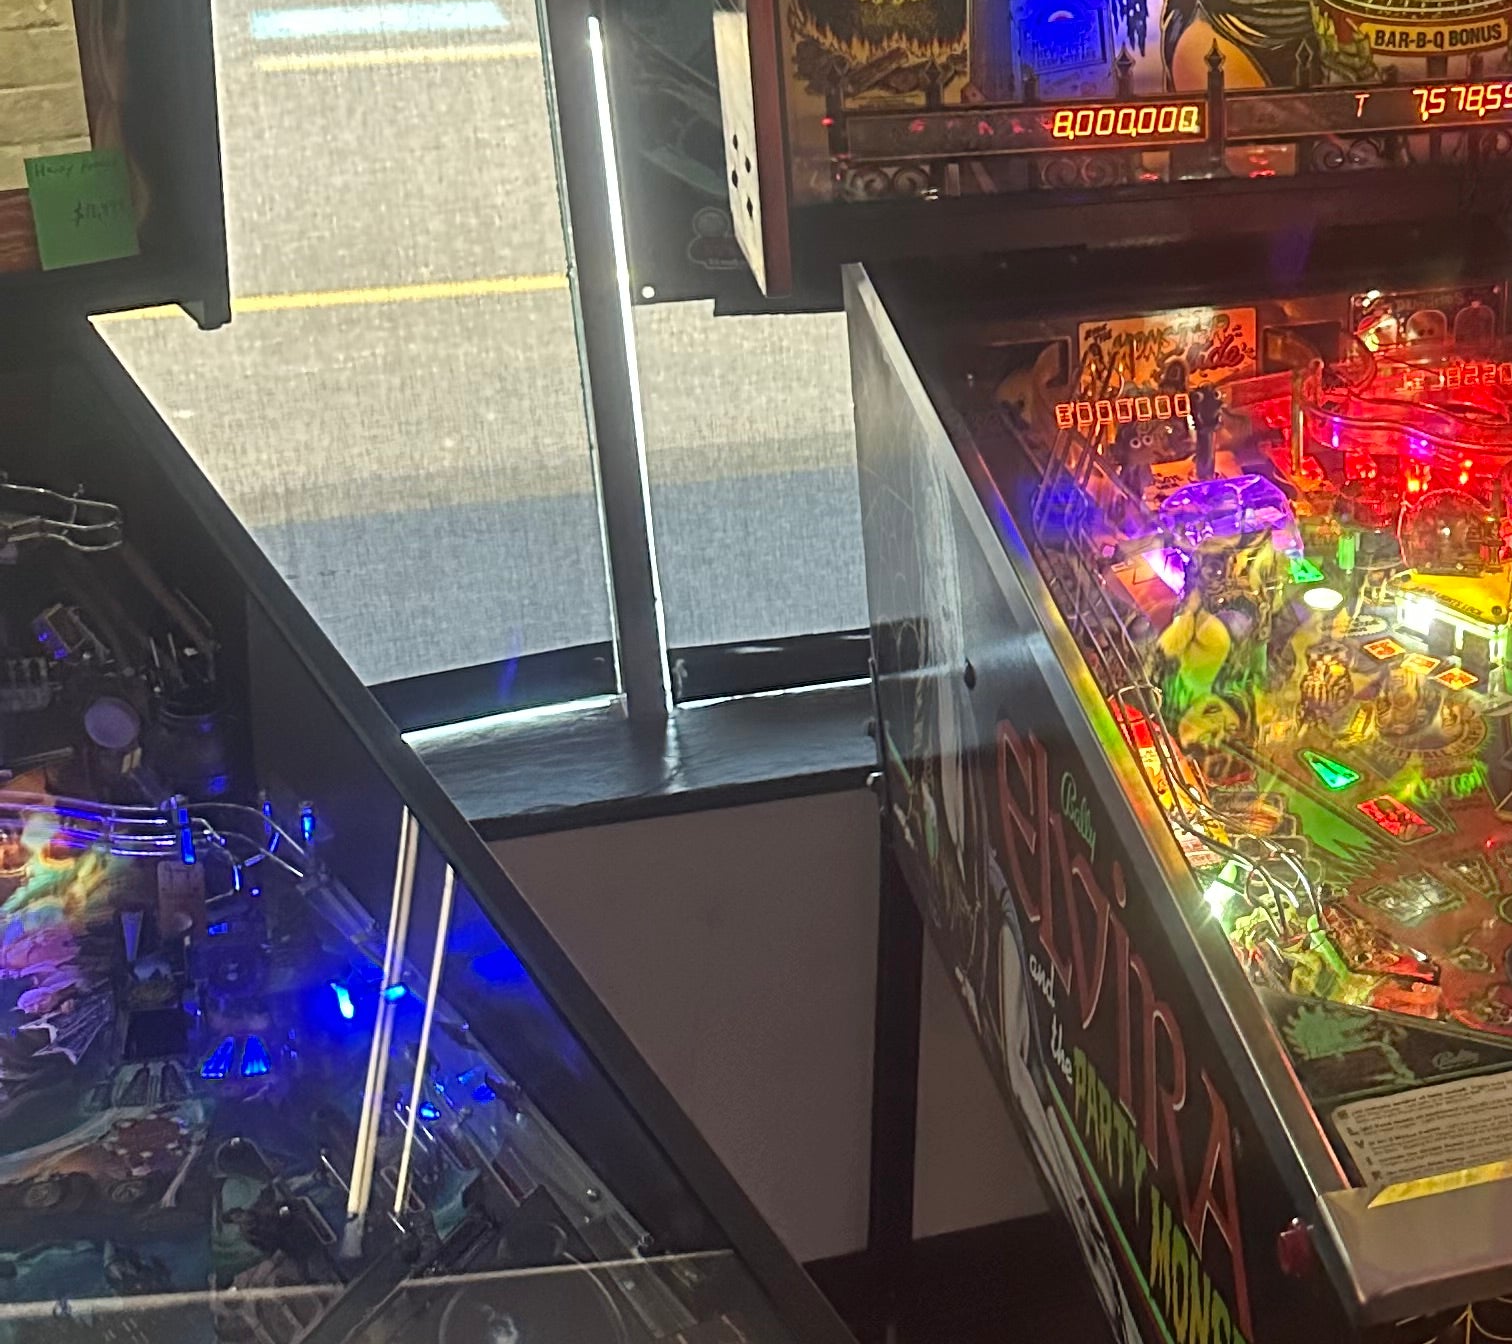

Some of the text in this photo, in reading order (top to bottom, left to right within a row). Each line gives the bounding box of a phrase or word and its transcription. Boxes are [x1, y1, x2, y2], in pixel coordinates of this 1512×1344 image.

[1373, 22, 1503, 51] BAR-B-Q BONUS
[1060, 771, 1097, 864] Bally
[1028, 954, 1056, 1009] and
[1050, 1014, 1075, 1085] the
[1073, 1044, 1149, 1222] PARTY
